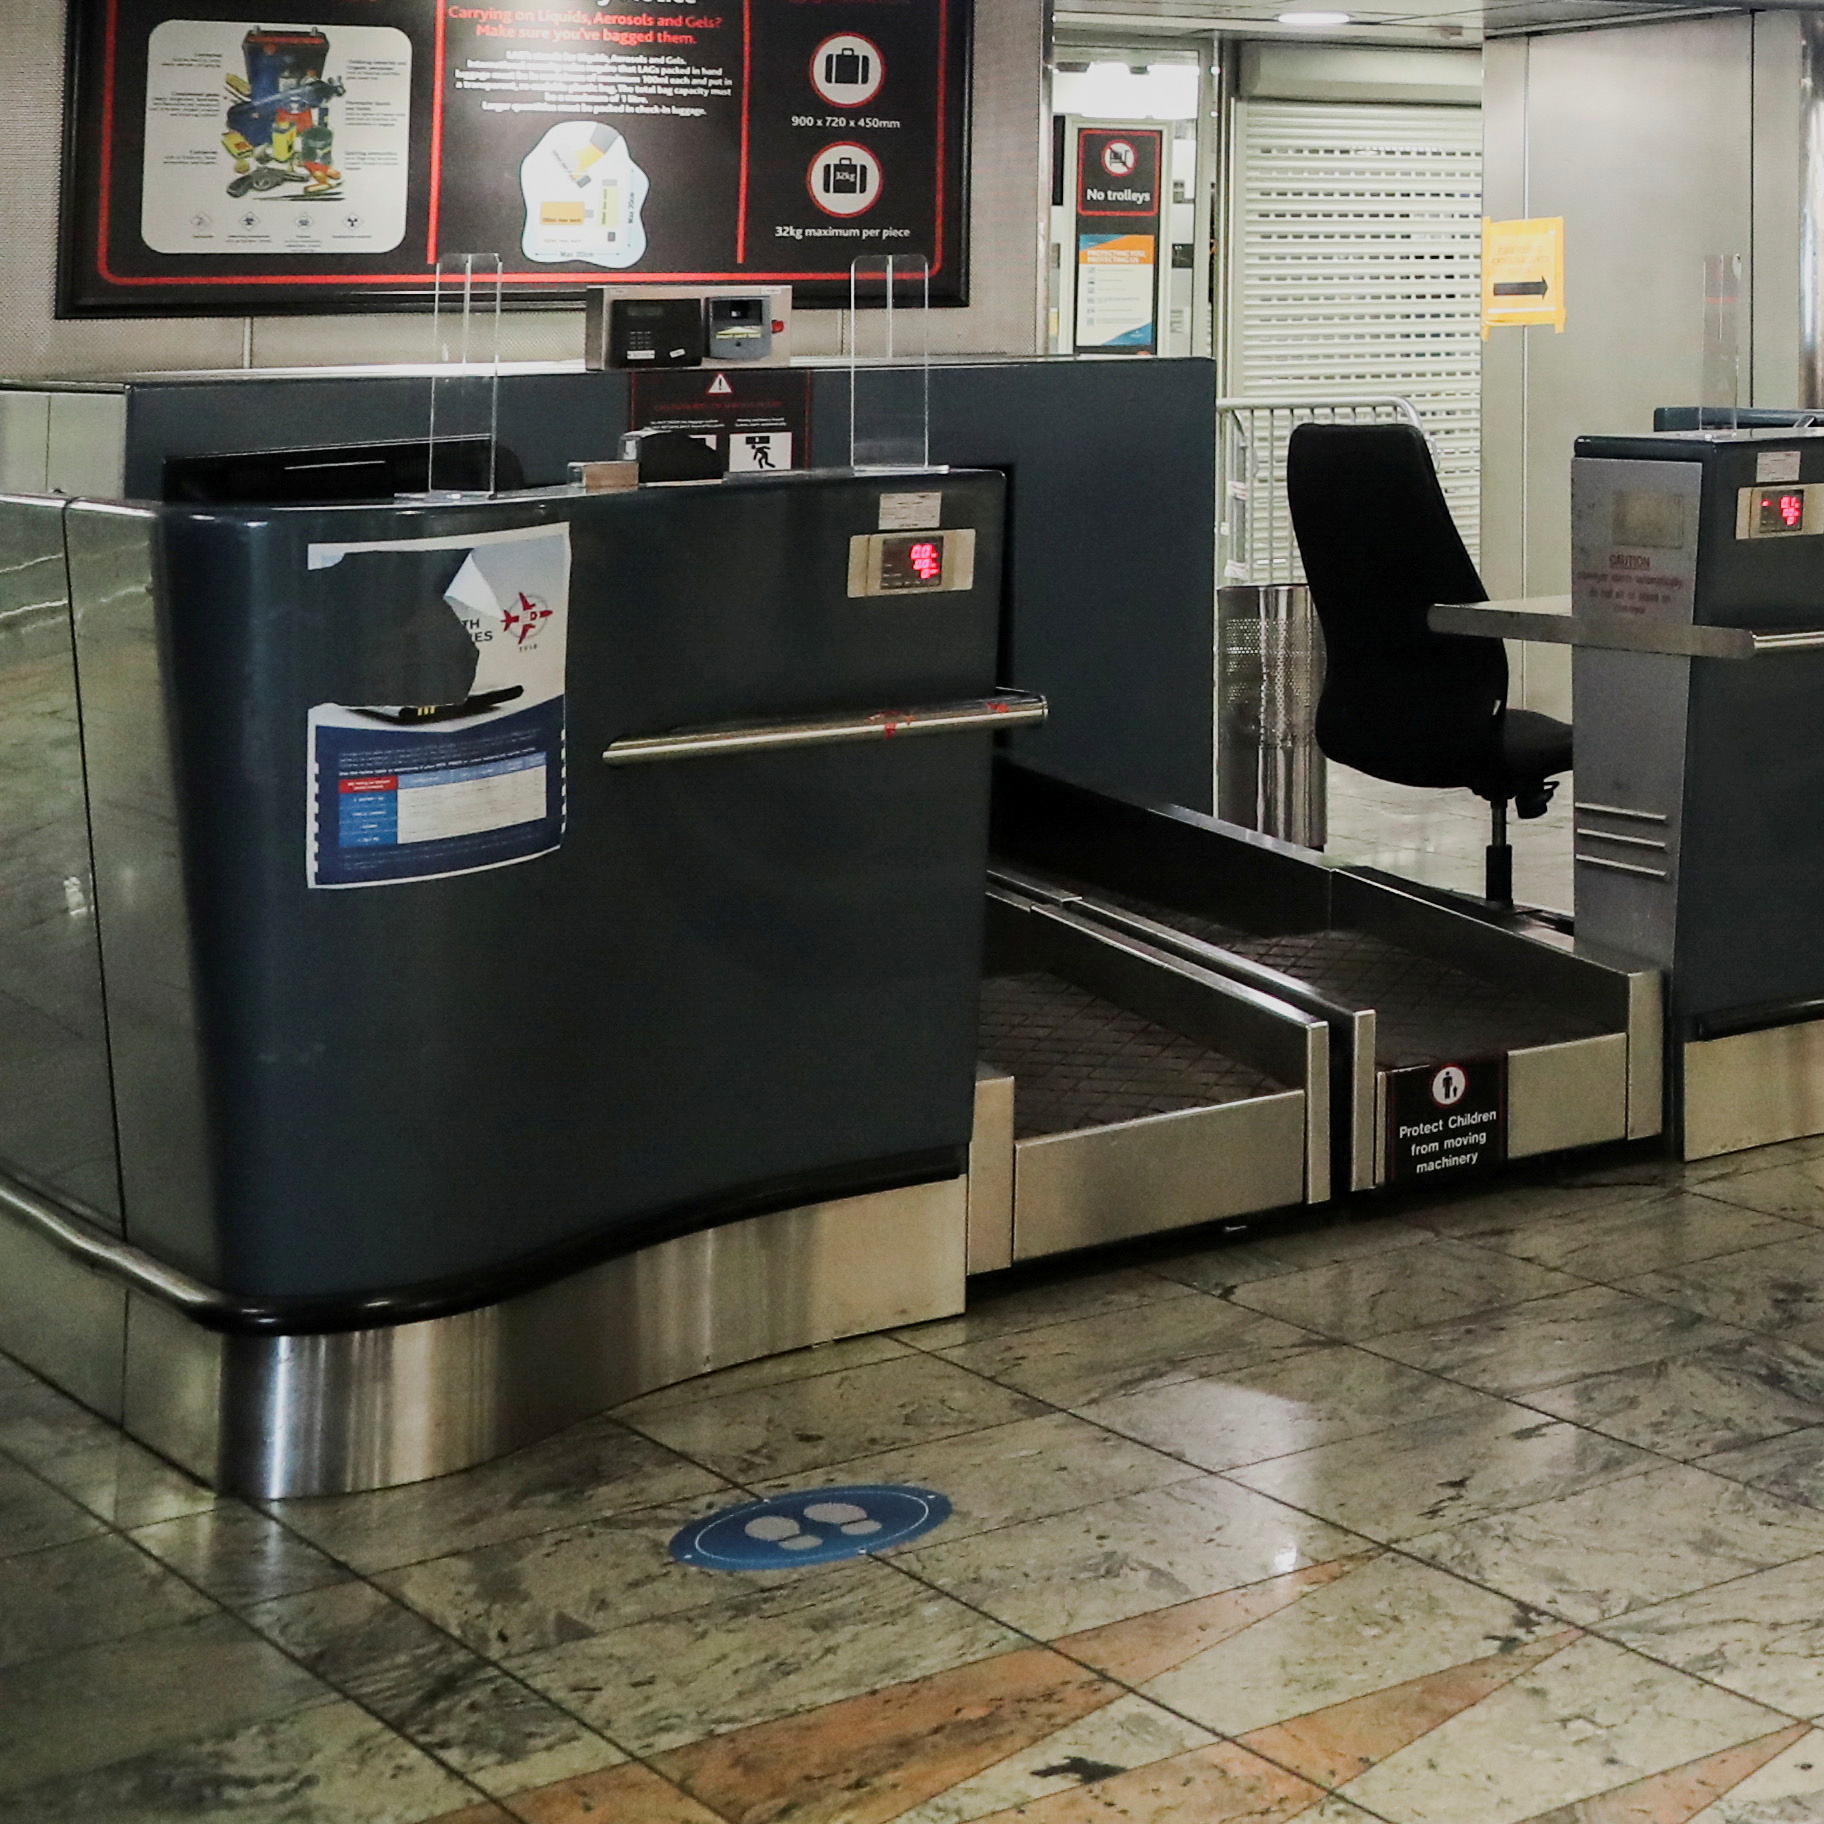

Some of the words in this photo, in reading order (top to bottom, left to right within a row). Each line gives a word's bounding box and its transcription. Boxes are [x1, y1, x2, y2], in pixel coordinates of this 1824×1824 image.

[449, 5, 515, 24] Carrying
[516, 10, 534, 21] on
[537, 9, 591, 26] Liquids,
[593, 12, 655, 27] Aerosols
[657, 15, 682, 28] and
[685, 16, 723, 29] Gels?
[476, 25, 515, 38] Make
[518, 27, 550, 39] sure
[552, 27, 601, 42] you've
[603, 30, 655, 46] bagged
[657, 31, 698, 45] them.
[791, 116, 814, 128] 900
[816, 119, 825, 128] x
[825, 116, 847, 128] 720
[849, 119, 857, 128] x
[857, 117, 901, 129] 450mm
[835, 171, 856, 182] 32kg
[1086, 188, 1105, 201] No
[1107, 188, 1151, 205] trolleys
[775, 226, 804, 240] 32kg
[805, 226, 860, 238] maximum
[862, 227, 879, 240] per
[882, 226, 911, 240] piece
[1609, 554, 1650, 570] CAUTION
[1399, 1119, 1444, 1138] Protect
[1447, 1110, 1497, 1129] Children
[1411, 1141, 1439, 1157] from
[1443, 1132, 1487, 1150] moving
[1416, 1152, 1479, 1174] machinery
